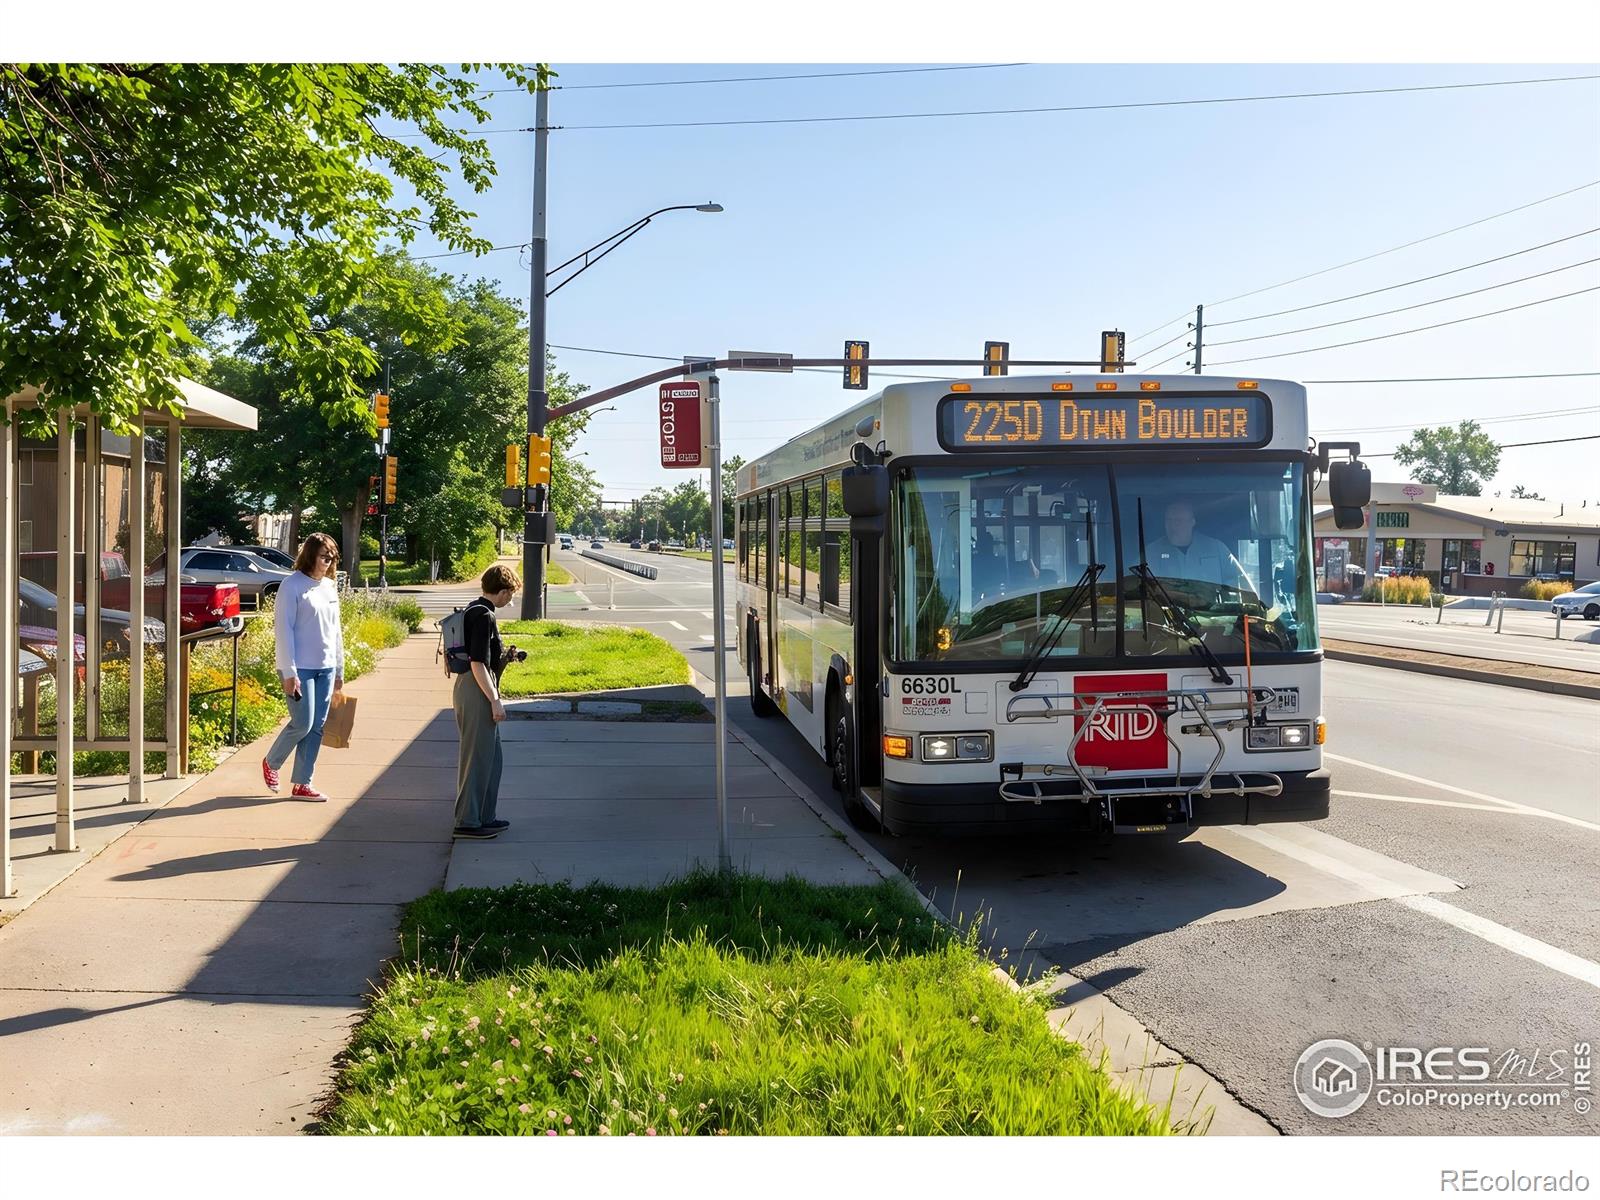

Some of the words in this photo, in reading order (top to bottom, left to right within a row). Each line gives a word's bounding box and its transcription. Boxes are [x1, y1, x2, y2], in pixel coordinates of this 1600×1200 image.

[661, 401, 675, 445] STOP
[964, 400, 1042, 441] 225D
[1138, 399, 1248, 439] BOULDER
[901, 677, 962, 694] 6630L
